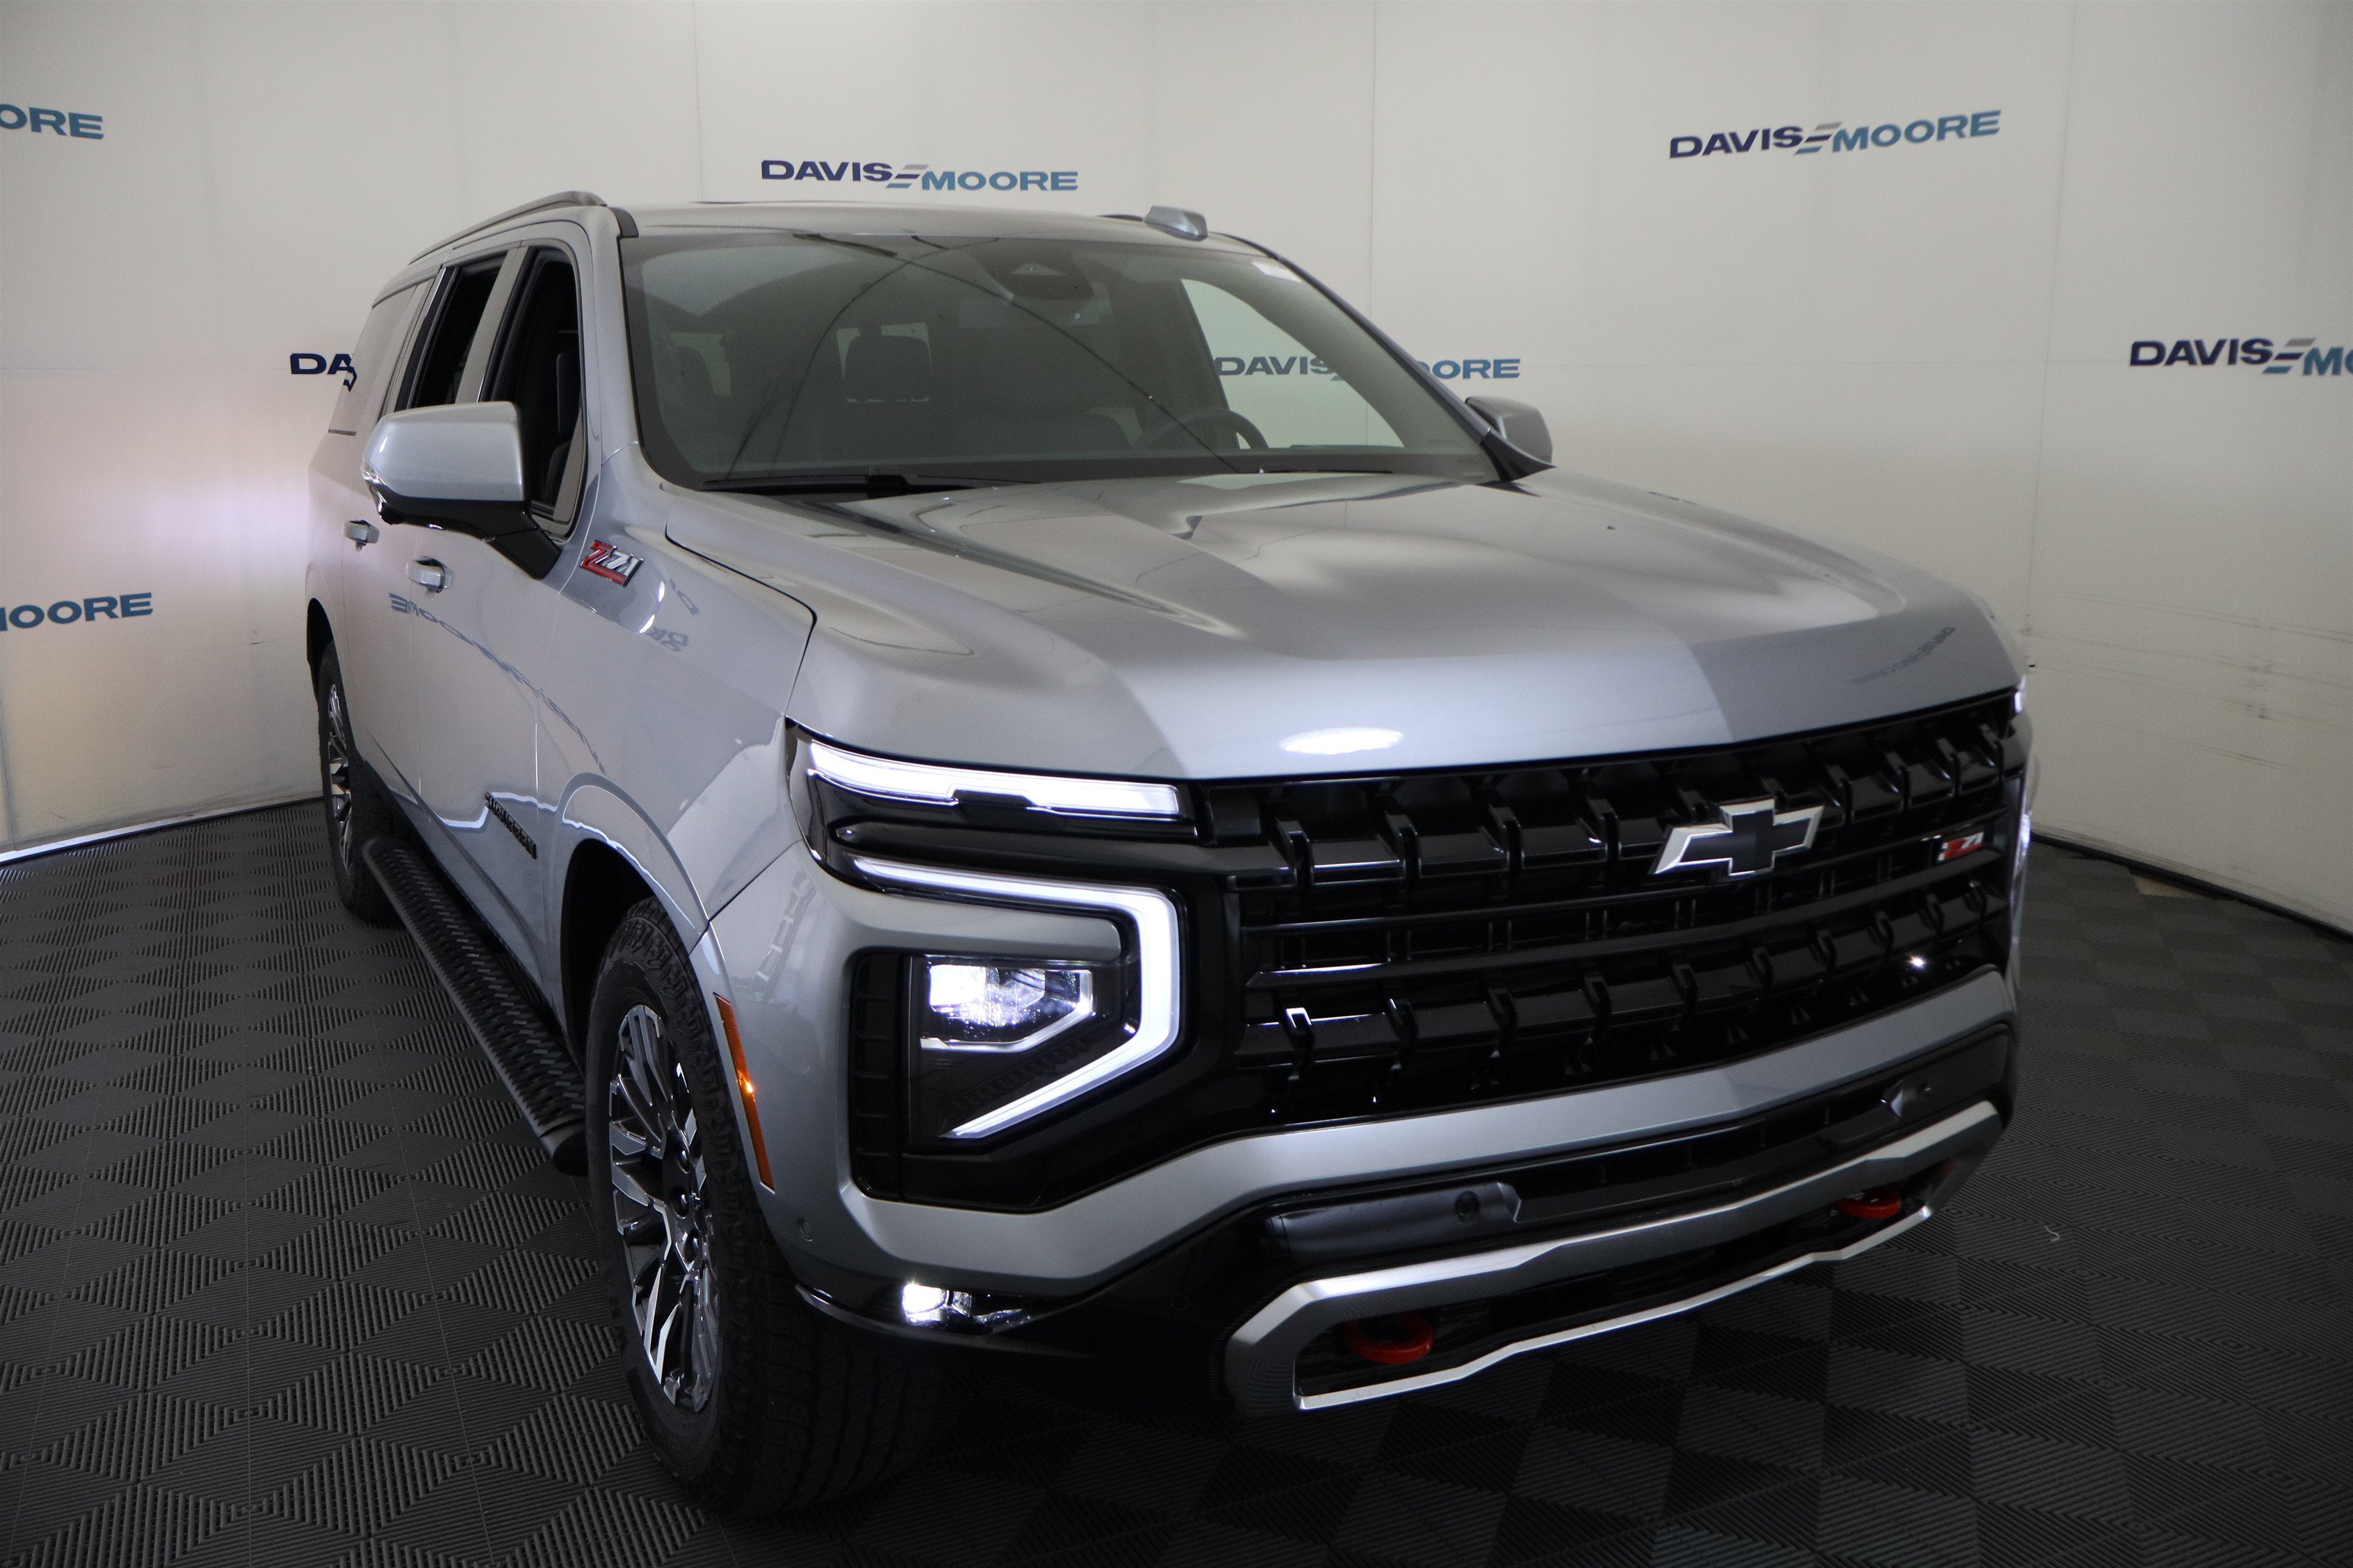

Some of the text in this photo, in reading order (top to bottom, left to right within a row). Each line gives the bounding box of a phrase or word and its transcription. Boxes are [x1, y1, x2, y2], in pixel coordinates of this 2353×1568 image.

[1670, 110, 2001, 159] DAVIS MOORE
[761, 160, 1079, 191] DAVIS MOORE
[2130, 338, 2353, 376] DAVIS M
[0, 592, 153, 631] OORE
